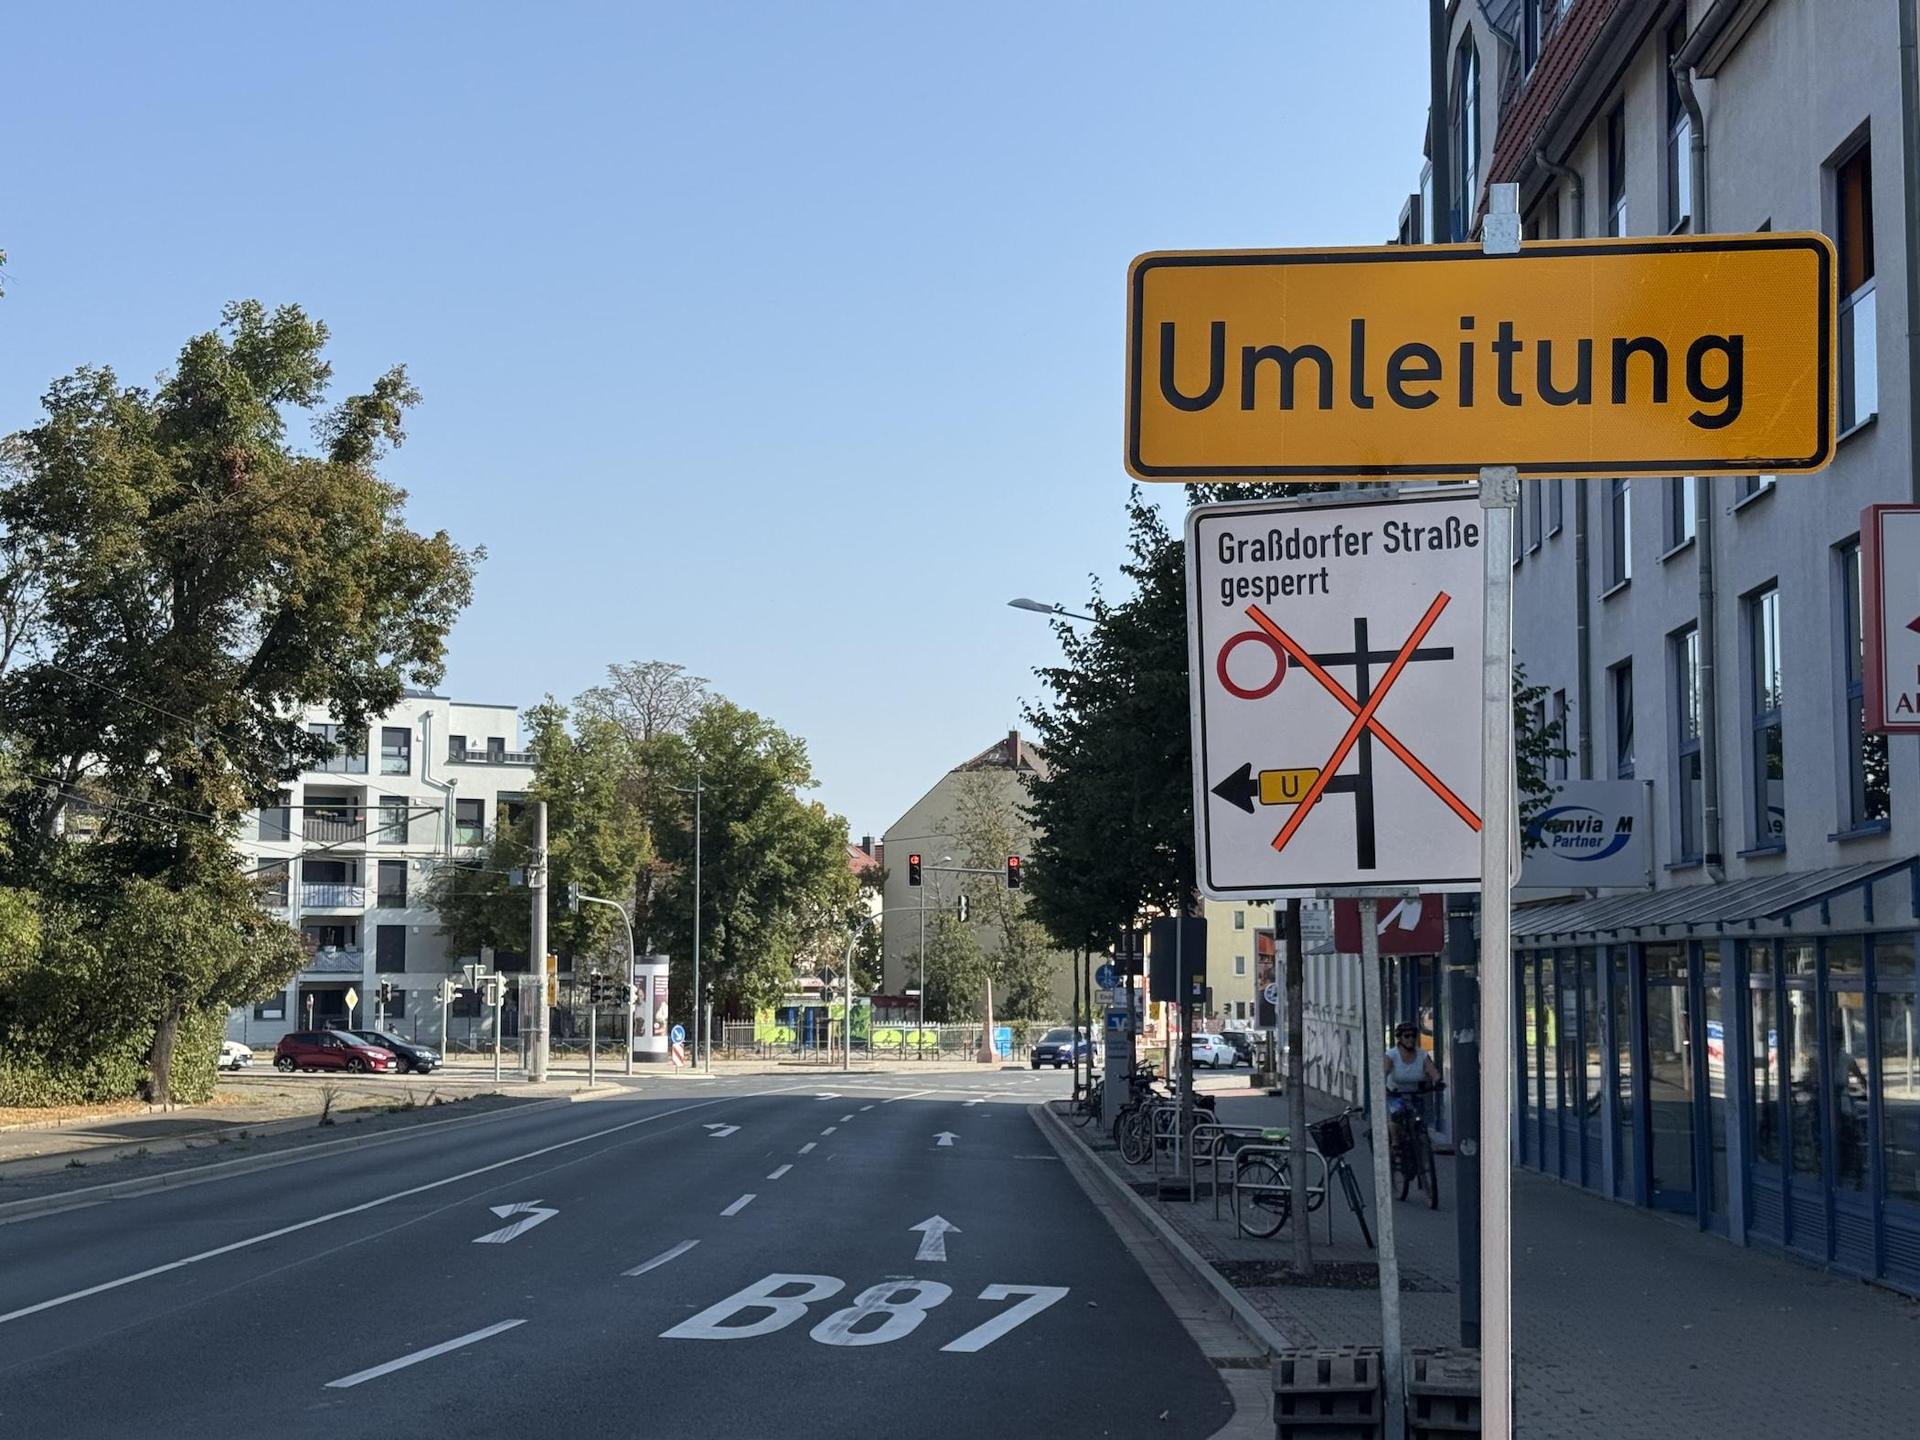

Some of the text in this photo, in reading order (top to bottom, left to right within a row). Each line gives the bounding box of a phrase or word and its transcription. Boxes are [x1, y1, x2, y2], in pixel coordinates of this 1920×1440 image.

[1159, 315, 1744, 430] Umleitung
[1218, 515, 1480, 565] Graßdorfer Straße
[1220, 566, 1330, 608] gesperrt
[1281, 775, 1299, 798] U
[1545, 815, 1634, 833] nvia M
[1552, 834, 1605, 848] Partner
[658, 1272, 1071, 1353] B87
